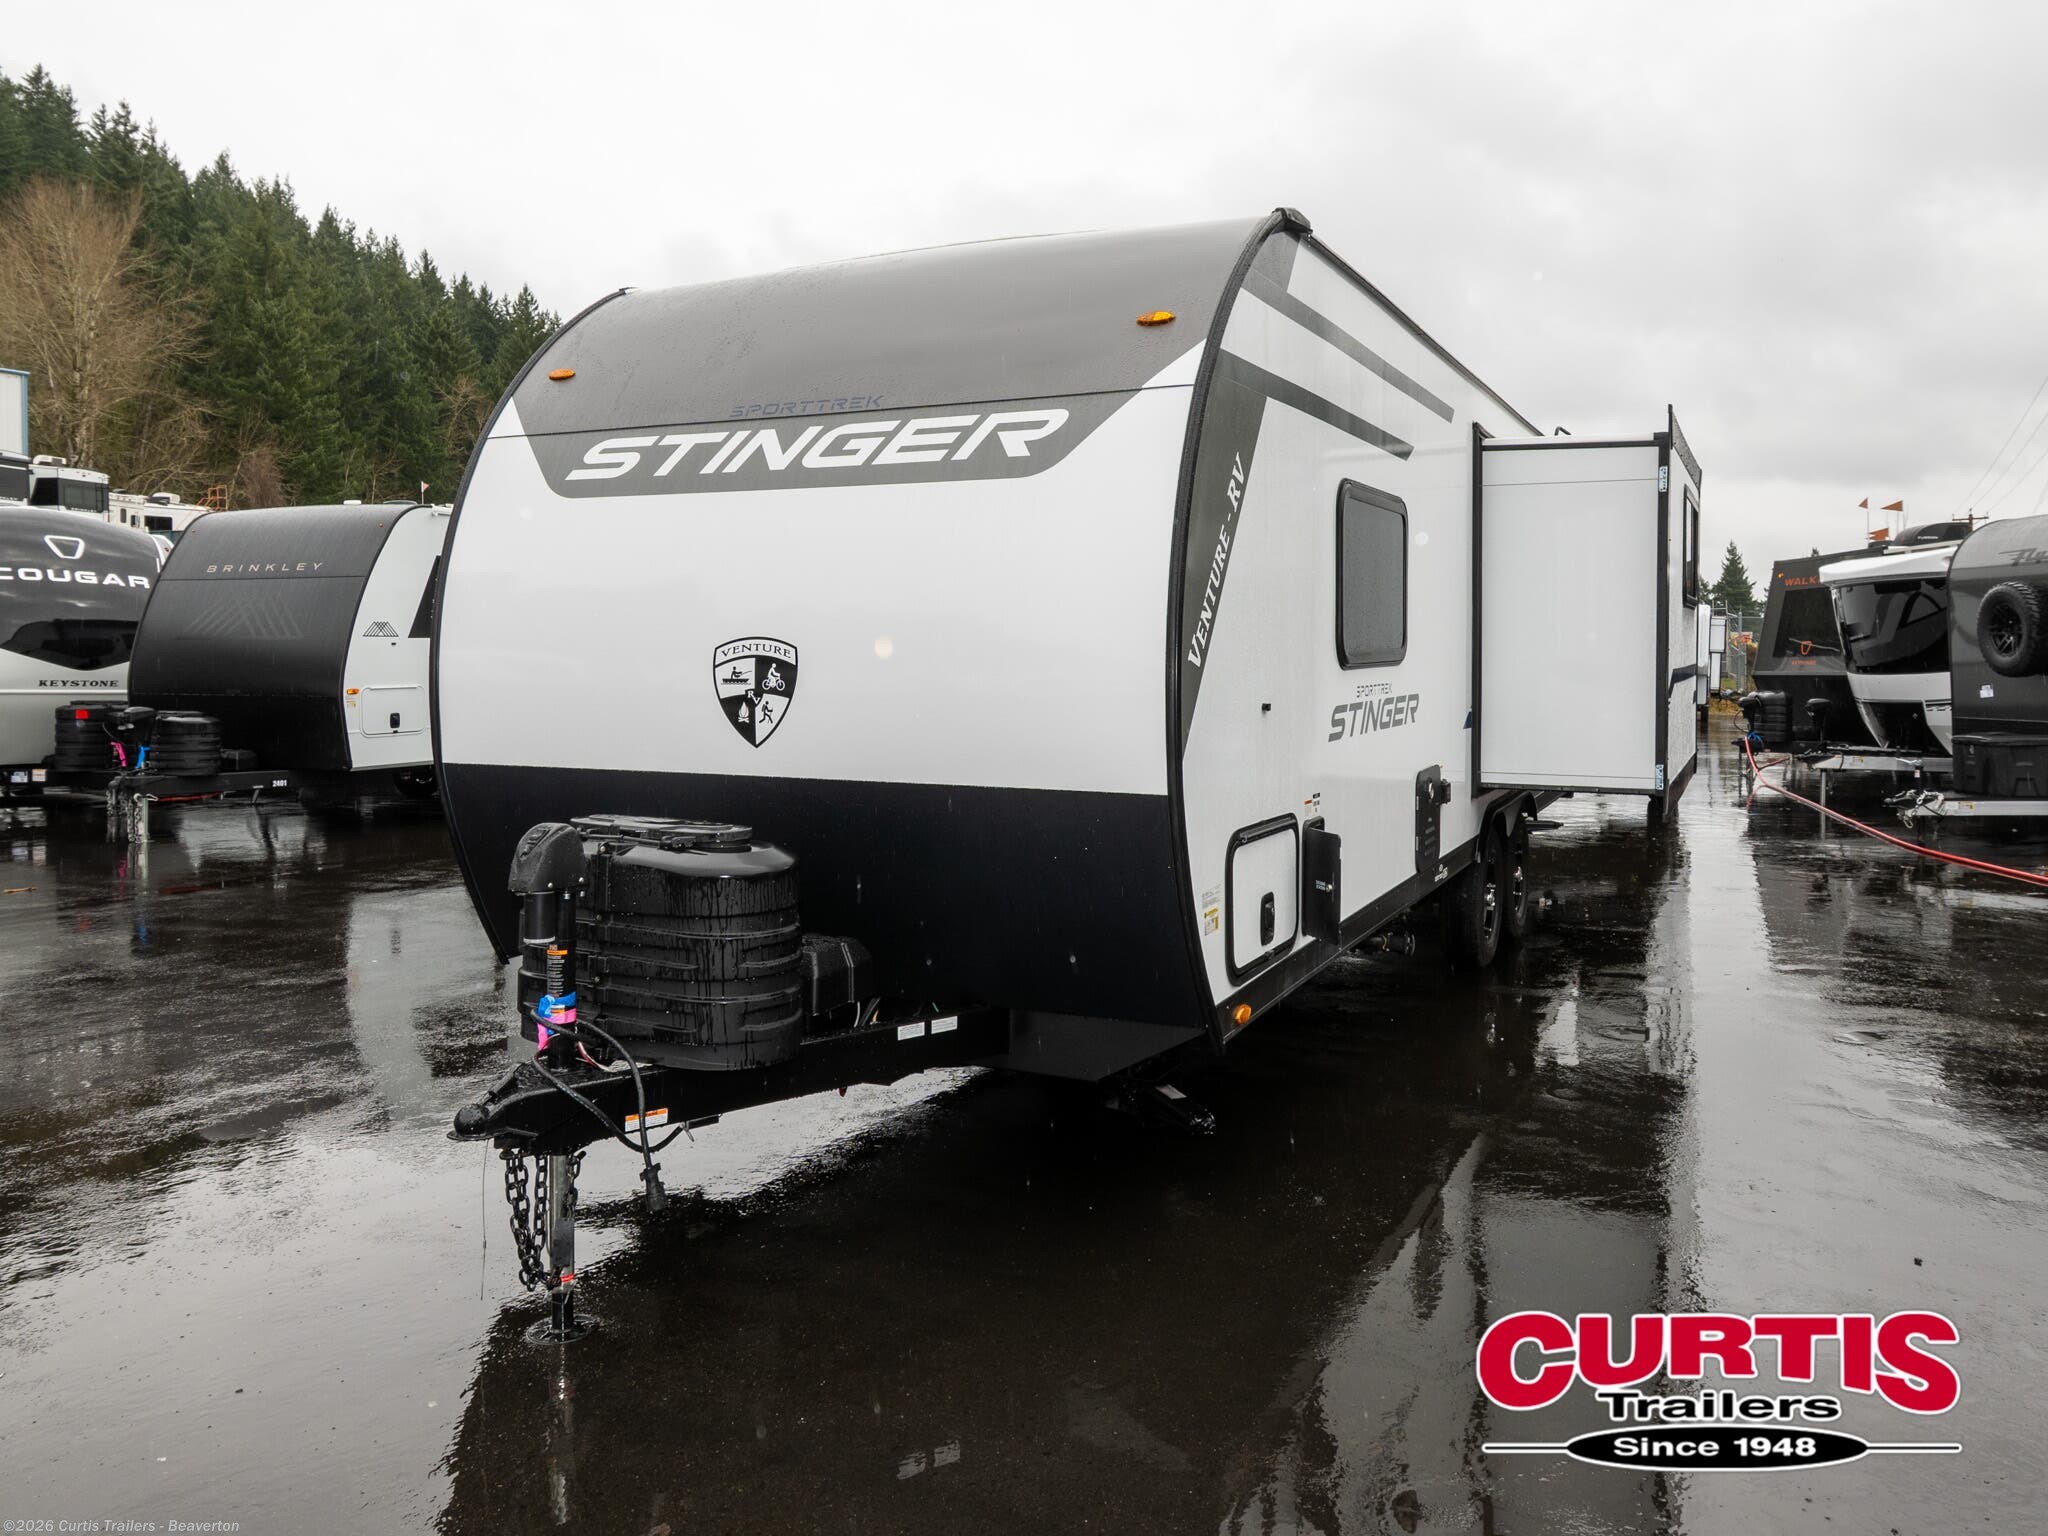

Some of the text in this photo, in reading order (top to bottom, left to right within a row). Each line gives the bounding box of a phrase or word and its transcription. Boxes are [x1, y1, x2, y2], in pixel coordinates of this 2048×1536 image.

[729, 395, 884, 418] SPORTTREK
[564, 408, 1070, 481] STINGER
[206, 562, 323, 573] BRINKLEY
[1187, 524, 1231, 668] VENTURE
[1226, 451, 1245, 513] RV
[721, 643, 792, 659] VENTURE
[38, 679, 119, 688] KEYSTONE
[1328, 693, 1420, 742] STINGER
